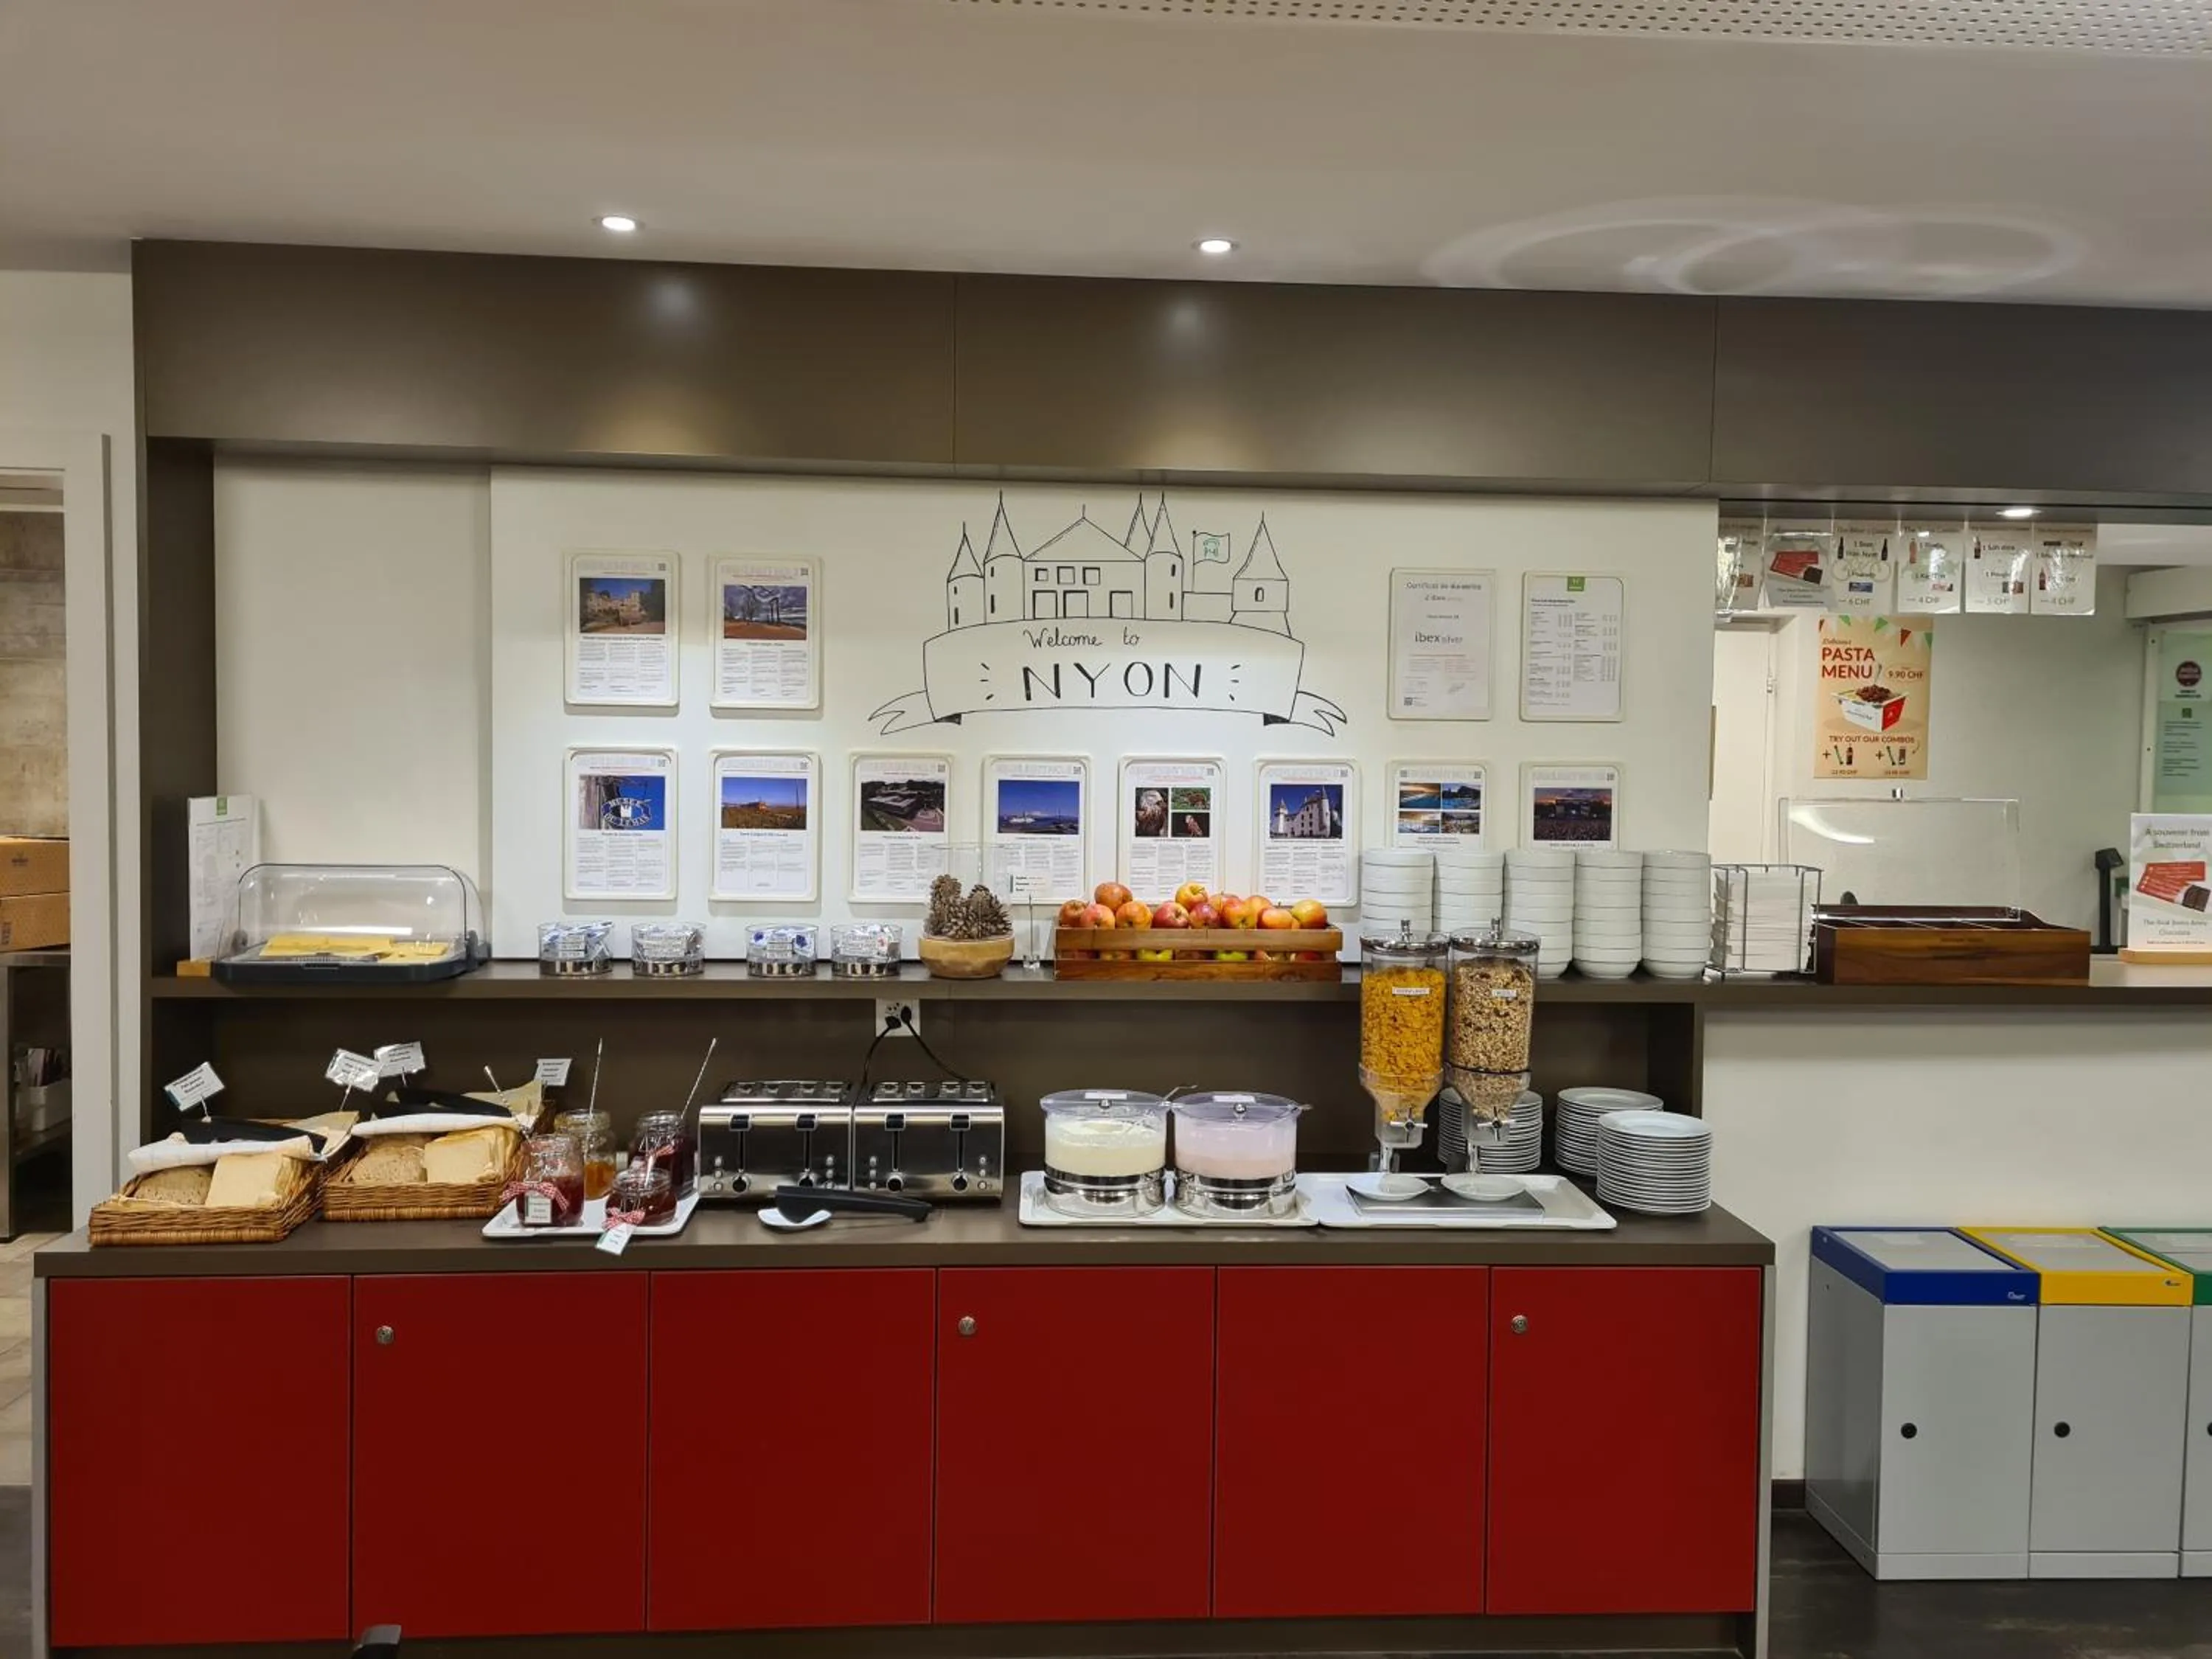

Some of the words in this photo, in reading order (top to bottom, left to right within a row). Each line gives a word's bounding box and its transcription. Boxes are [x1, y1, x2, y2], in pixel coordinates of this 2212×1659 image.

[1023, 627, 1105, 648] Welcome
[1123, 627, 1142, 646] to
[1415, 631, 1440, 642] ibex
[1821, 647, 1875, 661] PASTA
[1821, 664, 1873, 679] MENU
[1888, 670, 1905, 679] 9.90
[1907, 670, 1924, 679] CHF
[1023, 661, 1202, 701] NYON
[1845, 735, 1862, 743] OUT
[1881, 736, 1916, 744] COMBOS
